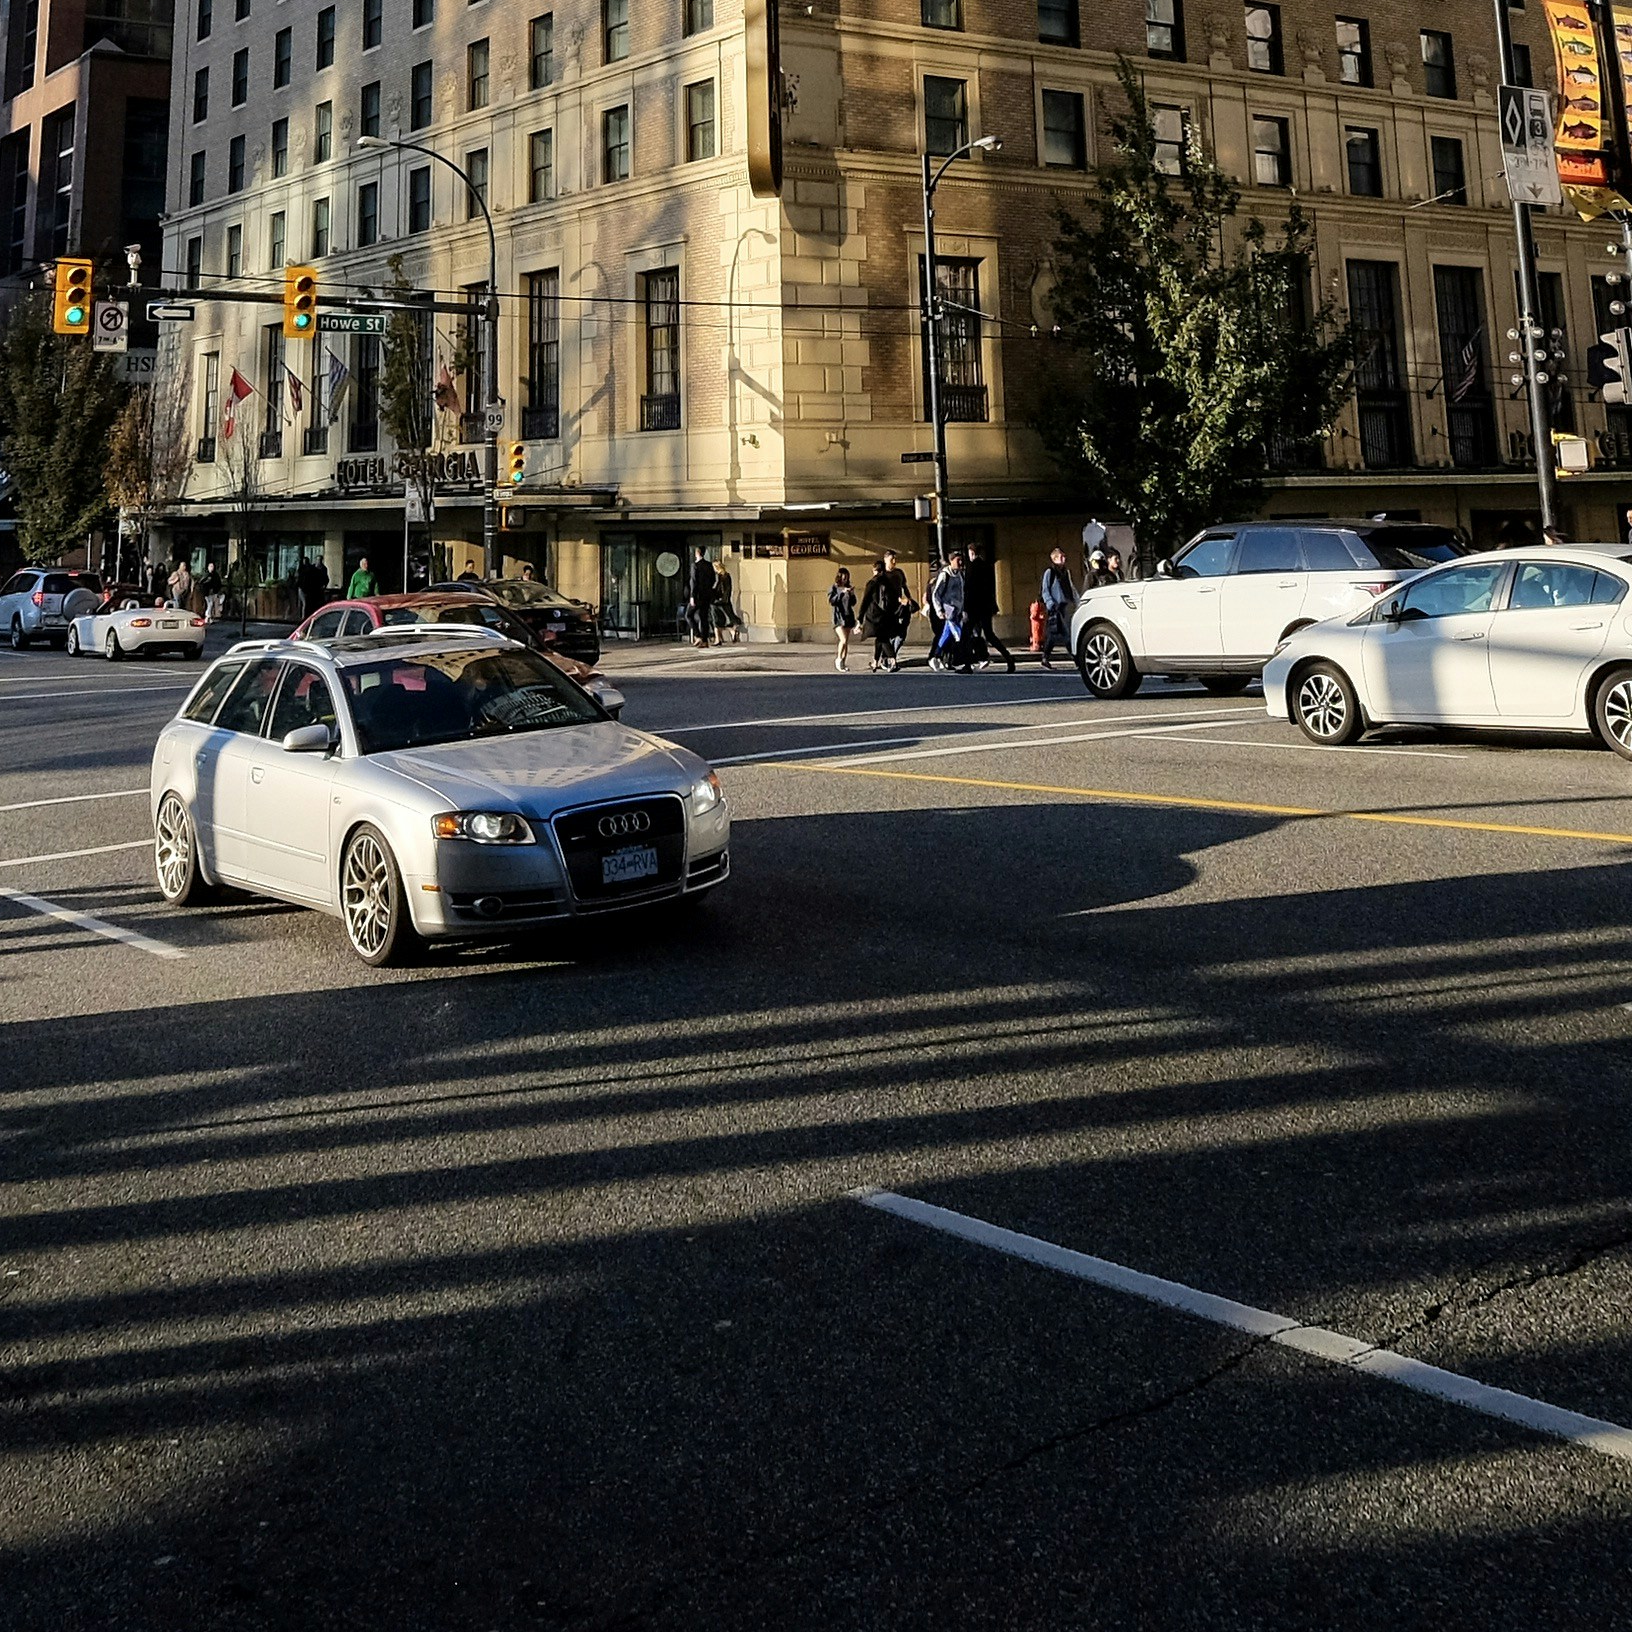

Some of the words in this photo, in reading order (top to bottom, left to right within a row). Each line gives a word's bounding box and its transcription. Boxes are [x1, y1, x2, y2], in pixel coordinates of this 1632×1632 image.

[1534, 121, 1543, 135] 3
[320, 317, 360, 331] Howe
[366, 318, 380, 331] St
[488, 413, 503, 426] 99
[337, 457, 388, 485] HOTEL
[790, 543, 828, 556] GEORGIA
